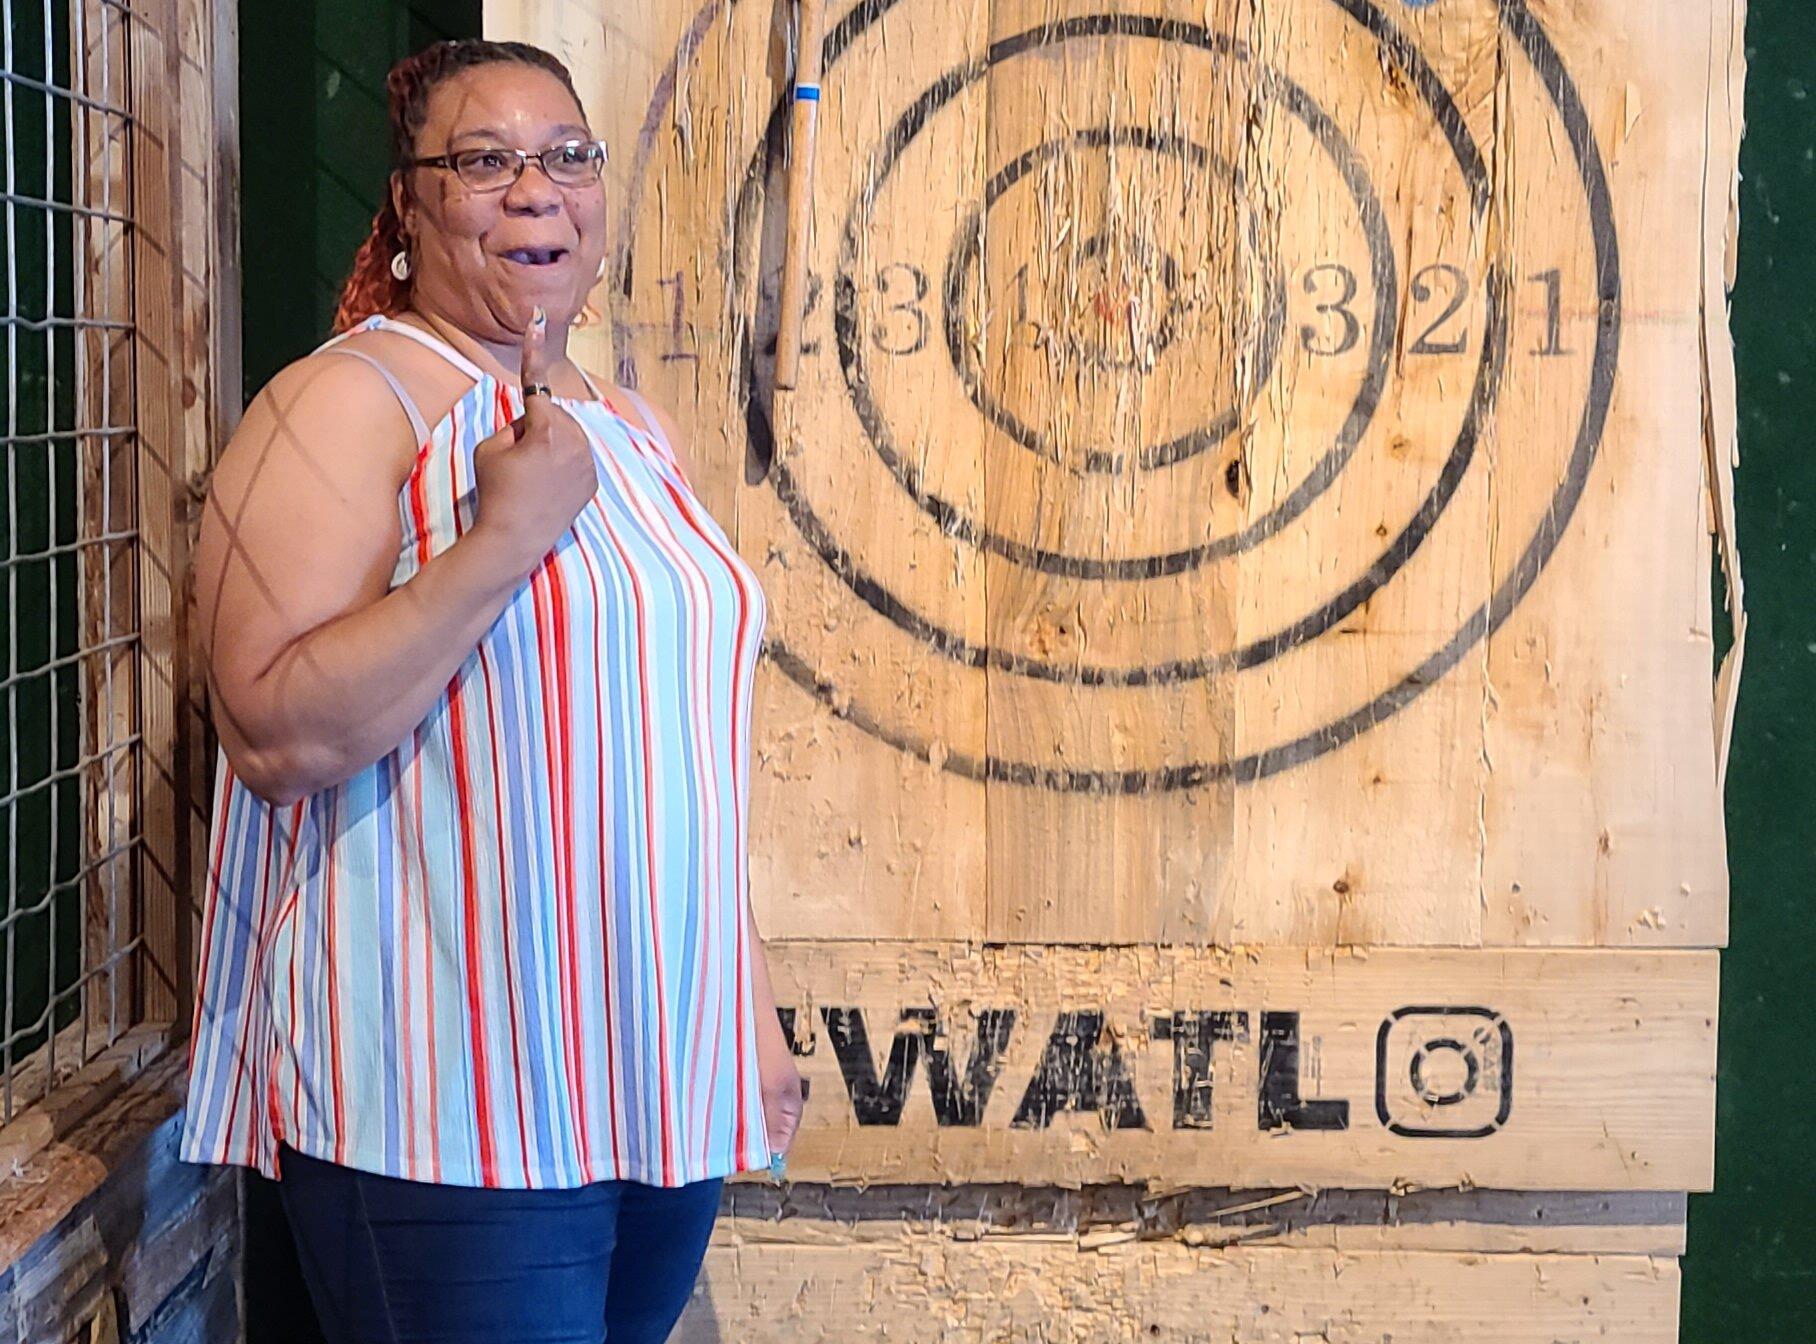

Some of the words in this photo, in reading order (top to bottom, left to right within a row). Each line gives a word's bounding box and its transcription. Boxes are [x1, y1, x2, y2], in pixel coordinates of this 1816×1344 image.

[655, 270, 699, 361] 1
[871, 262, 931, 355] 3
[1301, 263, 1360, 354] 3
[1408, 264, 1469, 354] 2
[1527, 268, 1576, 356] 1
[777, 1007, 1349, 1131] WATL
